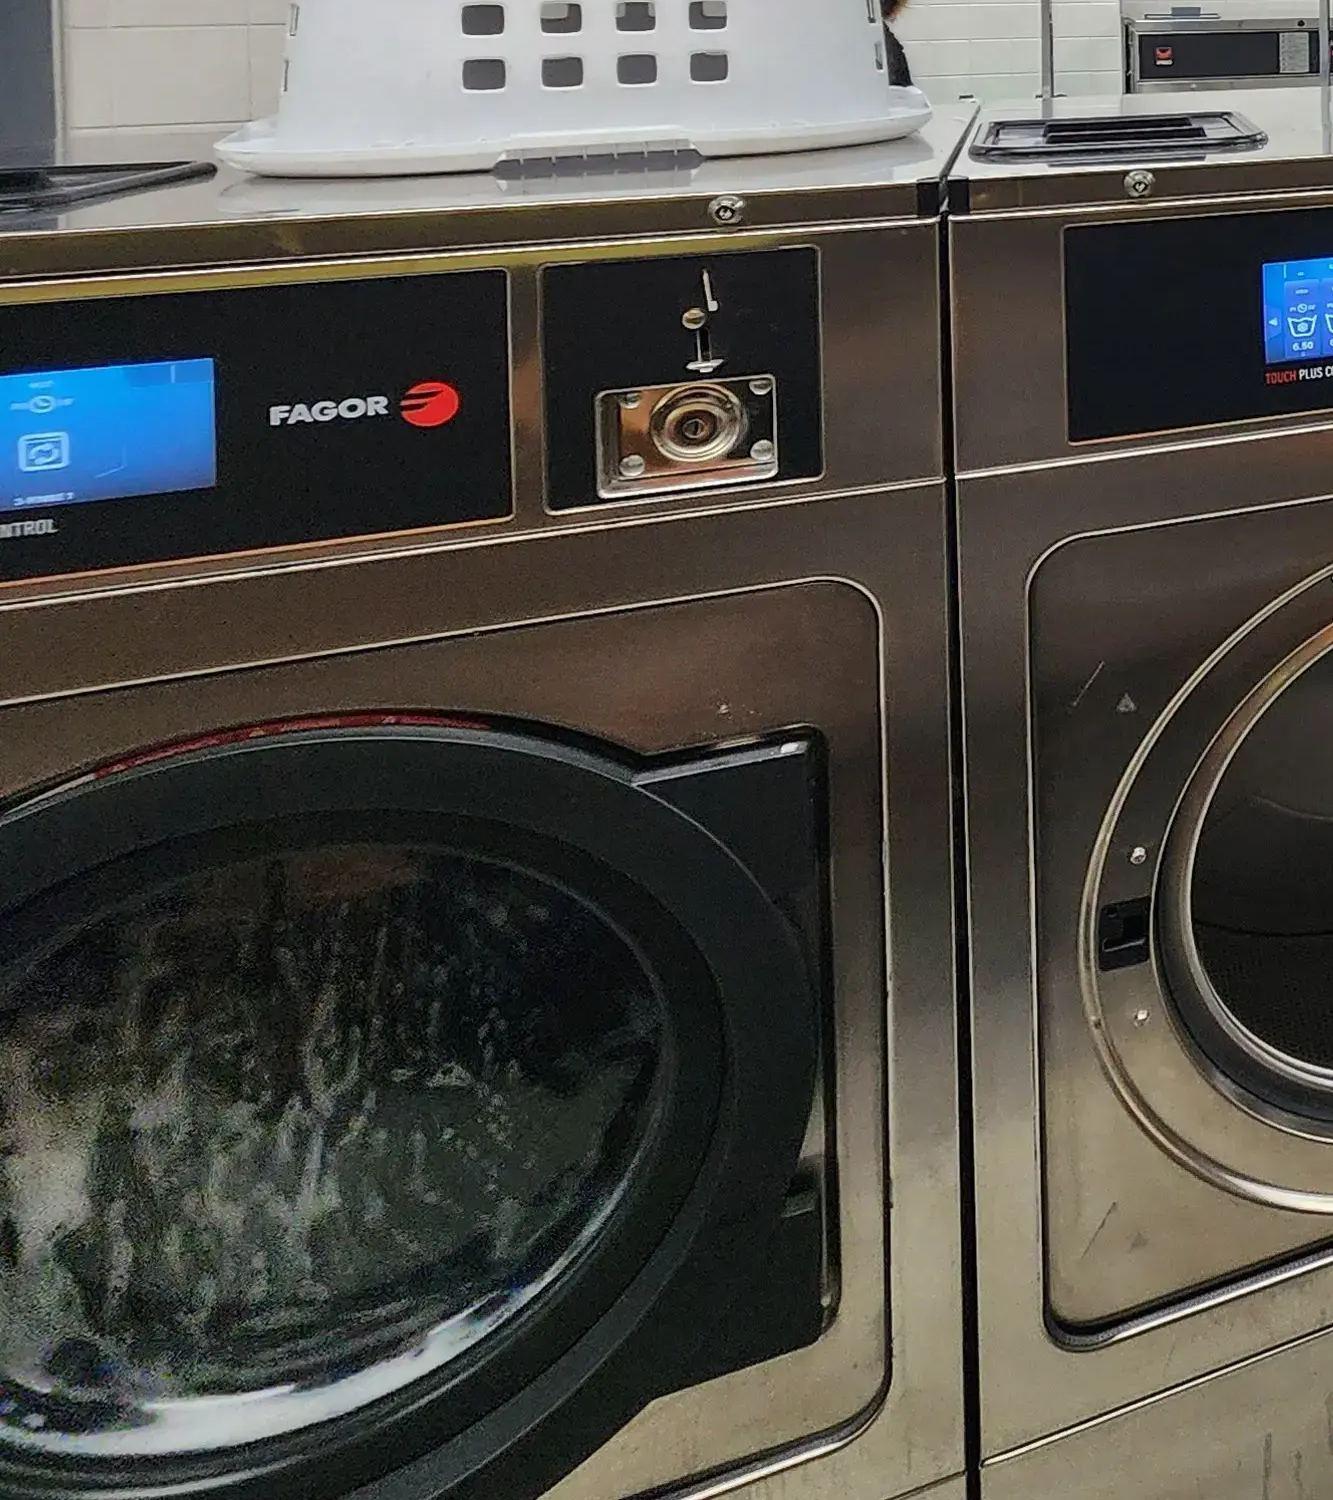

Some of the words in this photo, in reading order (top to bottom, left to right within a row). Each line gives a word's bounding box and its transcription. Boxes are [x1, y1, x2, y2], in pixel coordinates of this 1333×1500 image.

[1292, 341, 1314, 351] 6.50
[1265, 369, 1297, 385] TOUCH
[1298, 366, 1323, 380] PLUS
[269, 394, 389, 426] FAGOR
